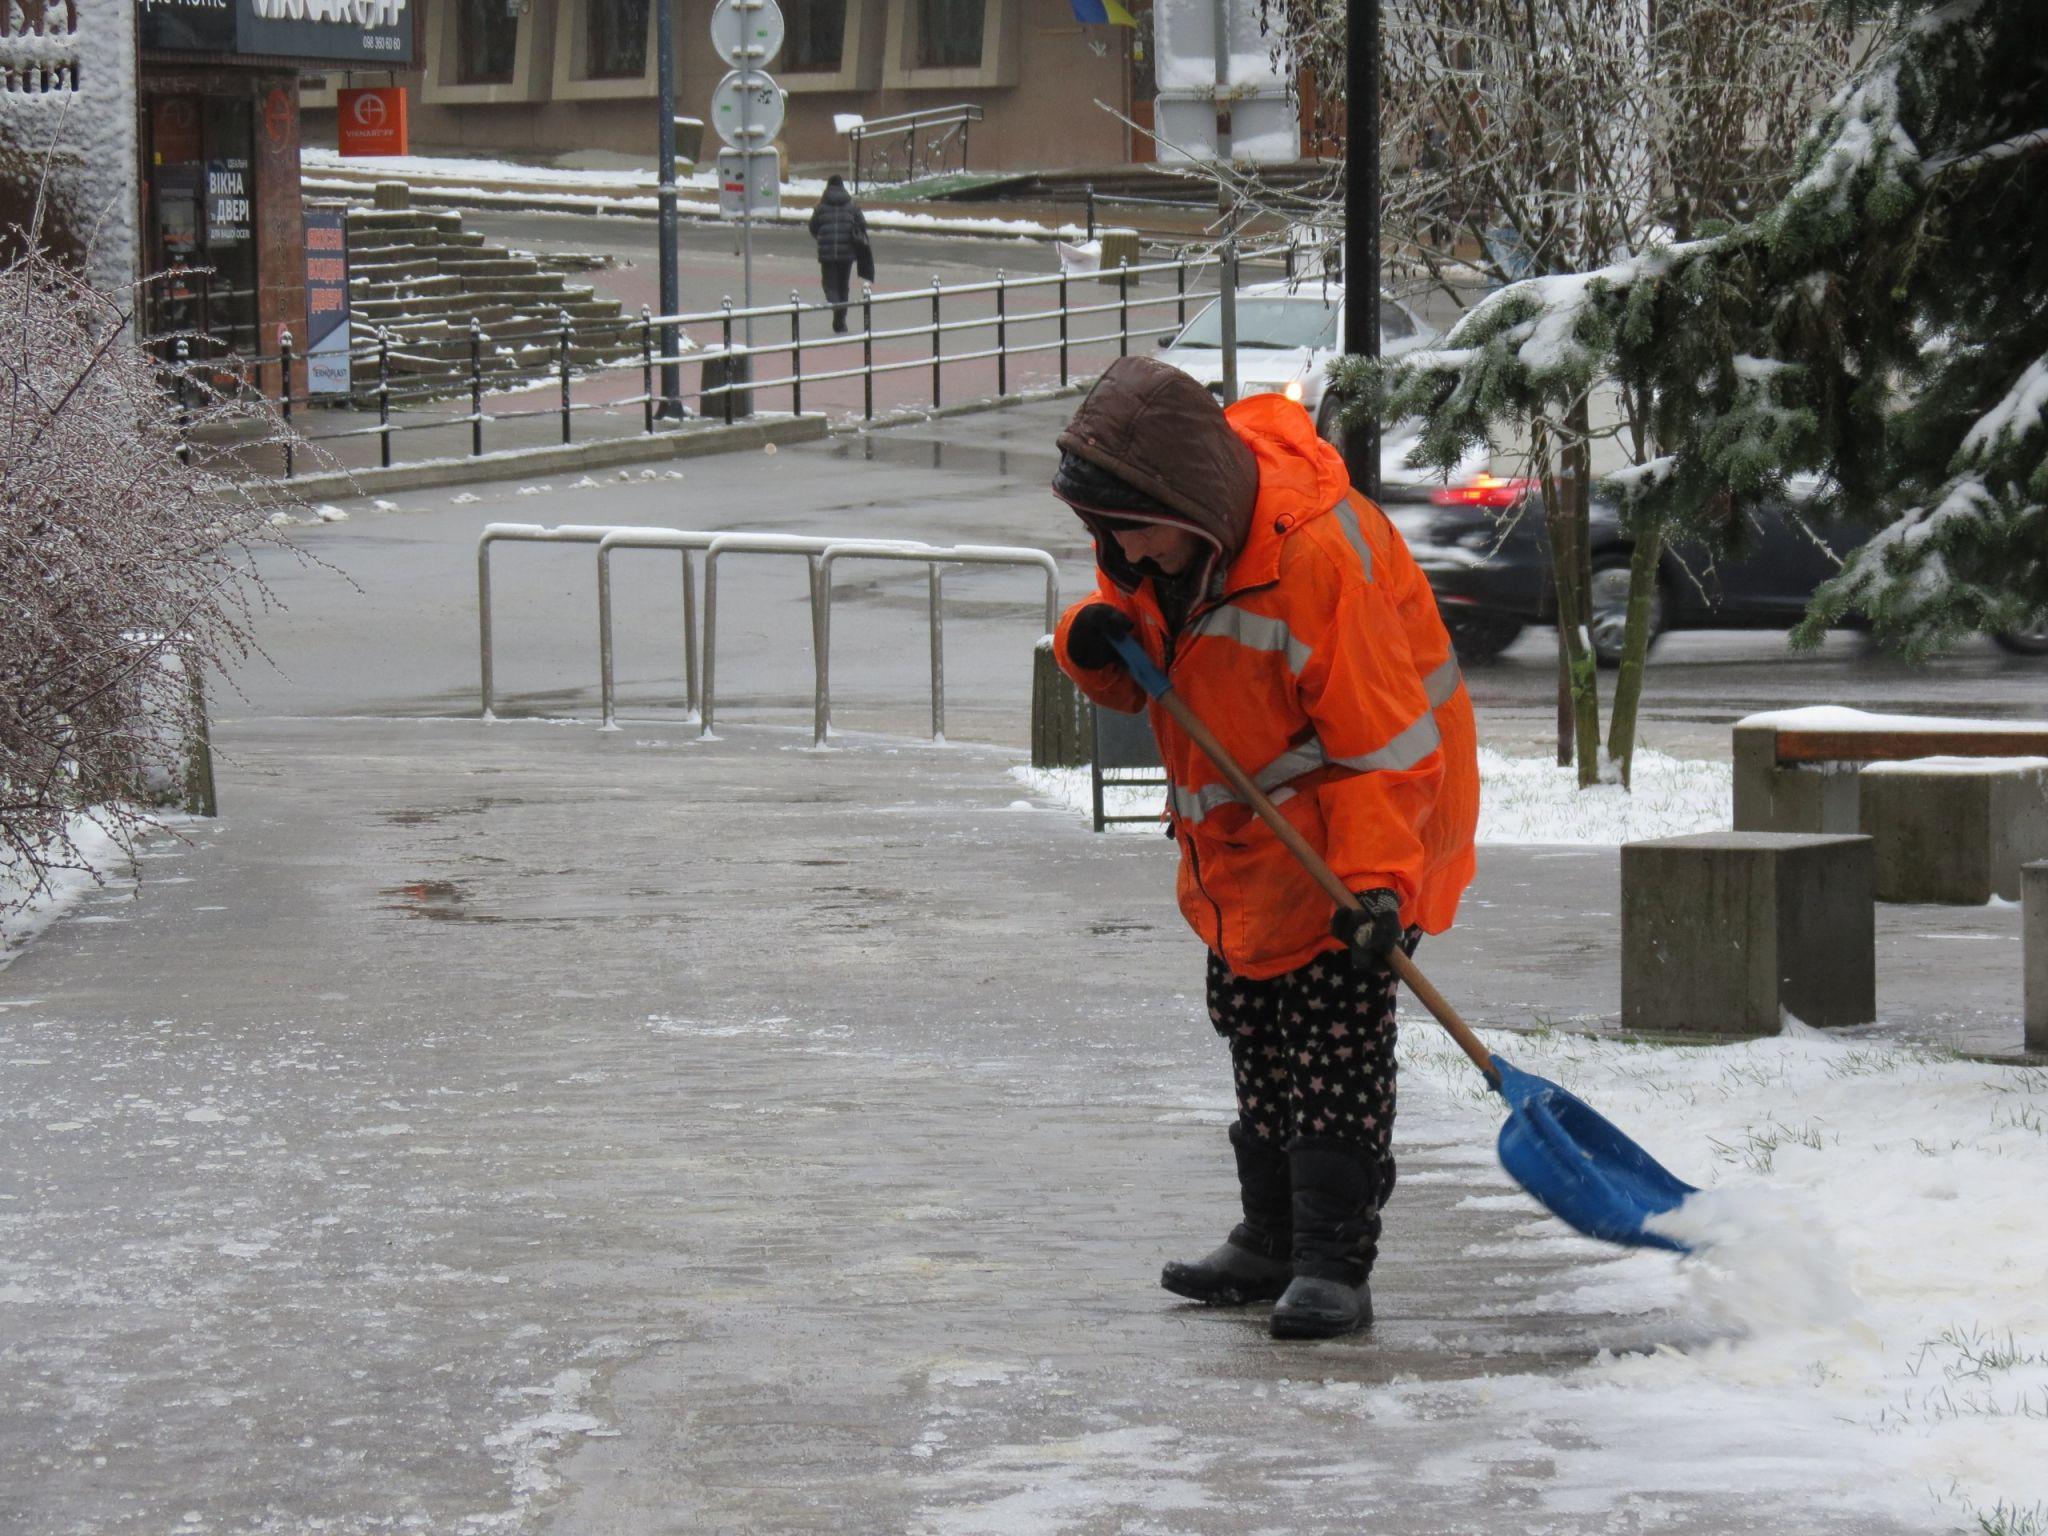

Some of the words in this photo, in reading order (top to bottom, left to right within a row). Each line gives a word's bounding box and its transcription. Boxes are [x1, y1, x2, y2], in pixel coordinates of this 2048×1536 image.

[393, 37, 401, 50] 60
[209, 172, 244, 194] ВІКНА
[217, 199, 249, 225] ДВЕРІ
